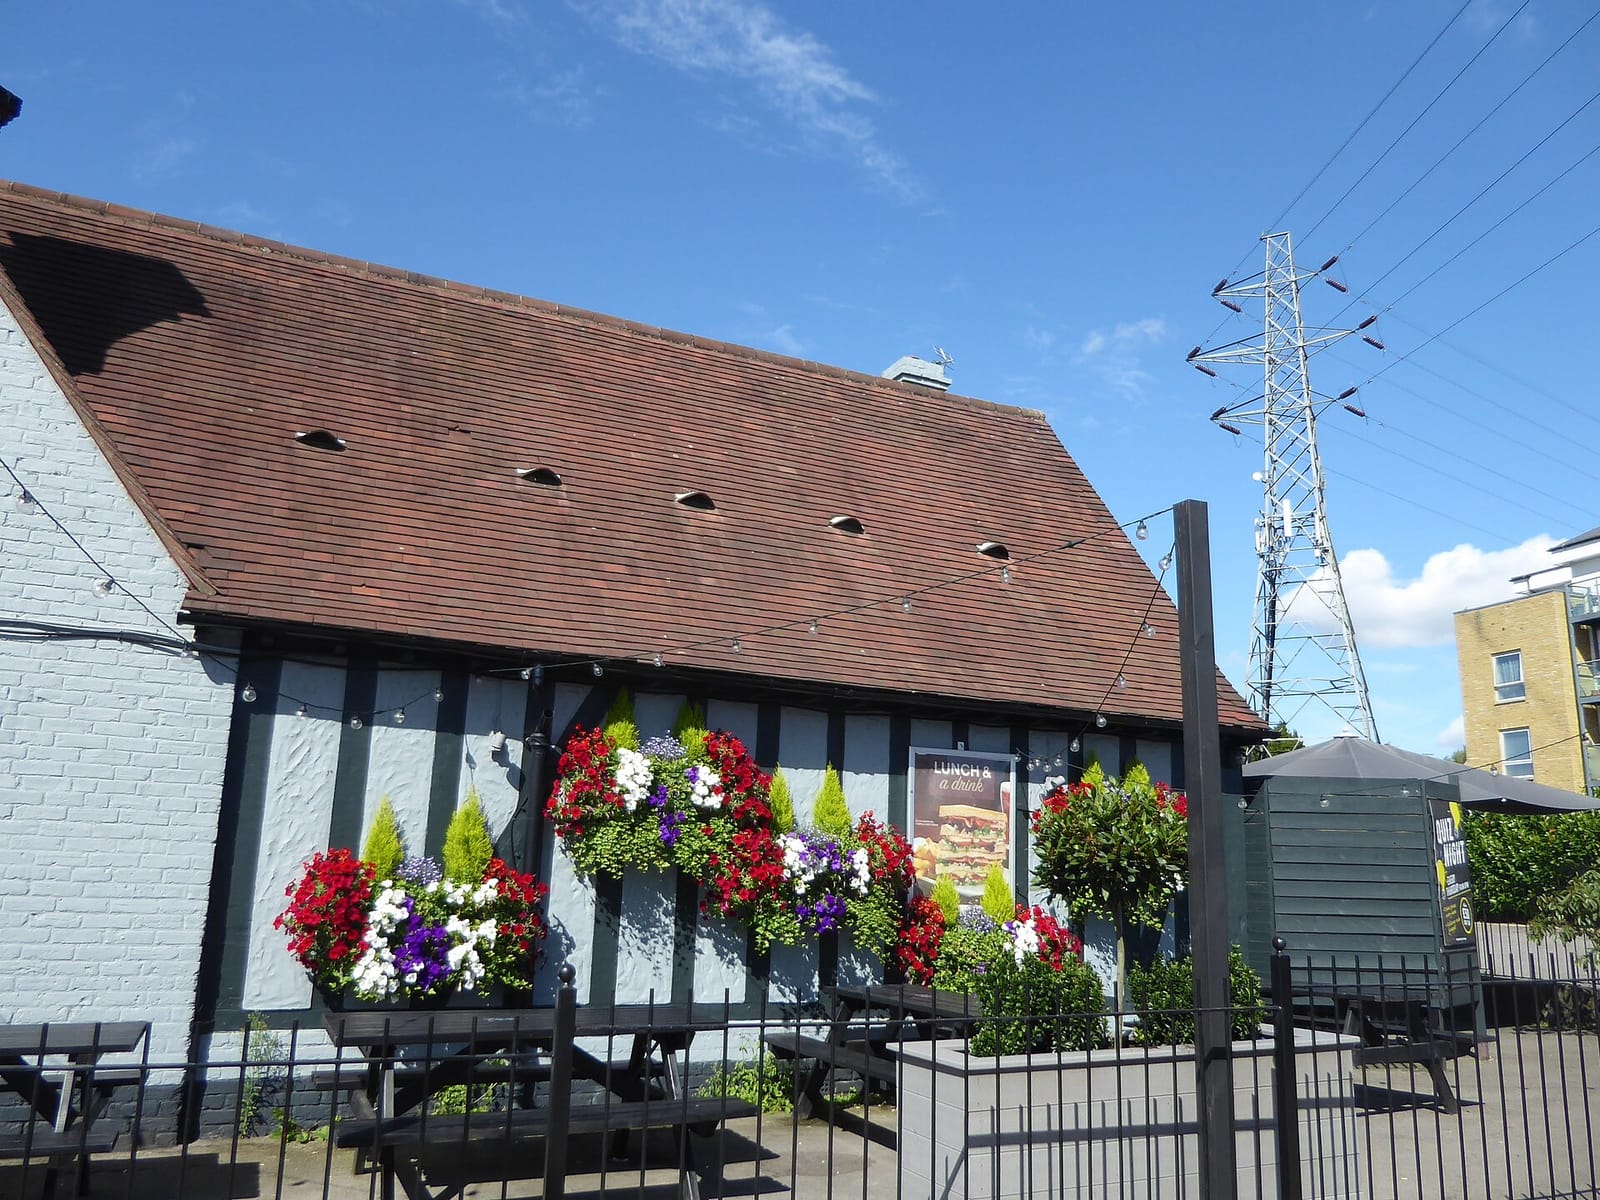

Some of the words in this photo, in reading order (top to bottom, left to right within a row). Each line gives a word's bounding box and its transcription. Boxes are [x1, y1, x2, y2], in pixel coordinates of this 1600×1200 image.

[934, 761, 980, 777] LUNCH
[982, 765, 991, 778] &
[939, 779, 949, 789] a
[951, 776, 983, 792] drink
[1436, 817, 1454, 845] QUIZ
[1443, 840, 1466, 867] NIGHT
